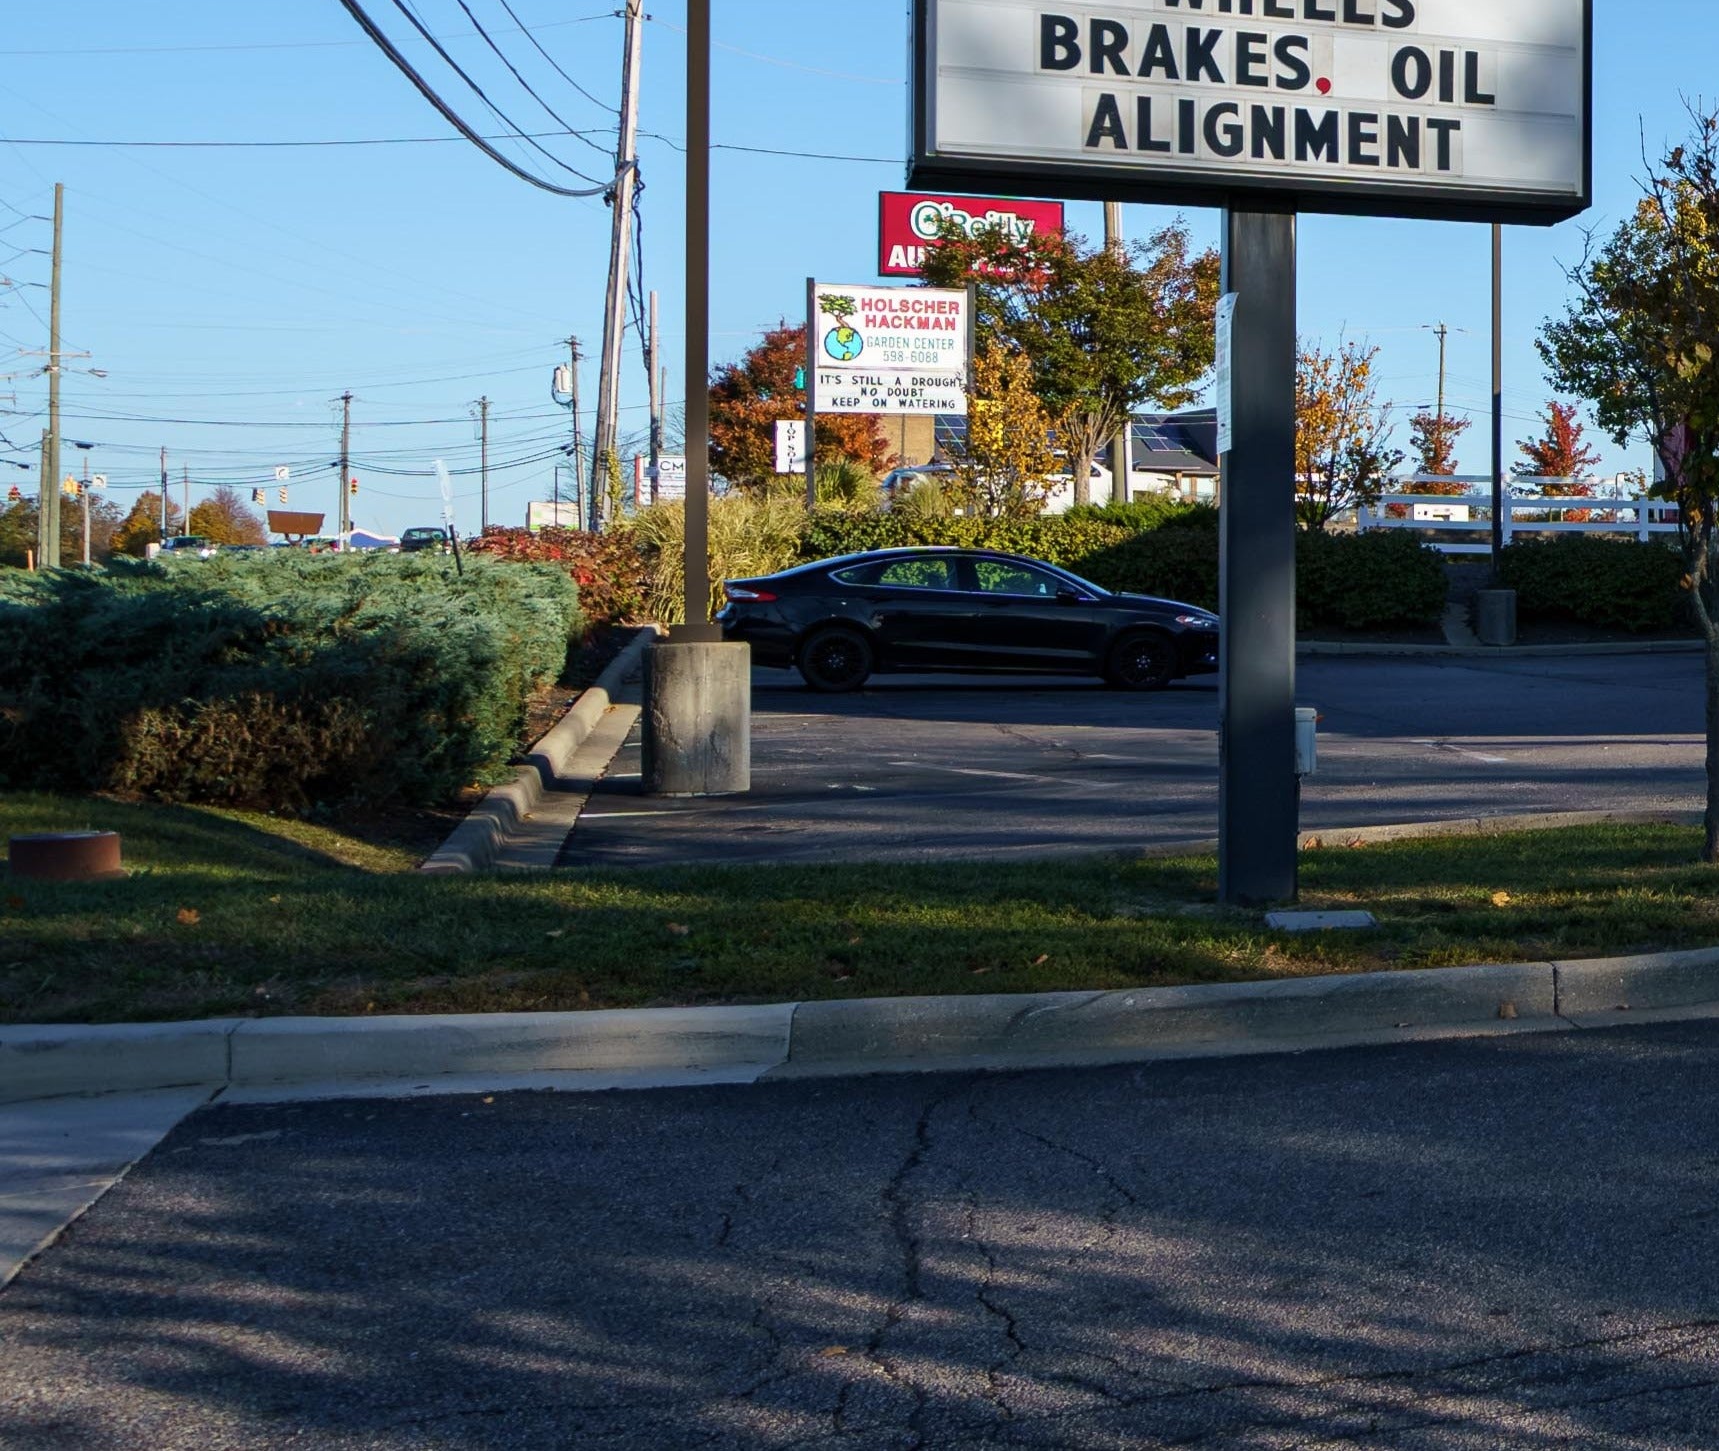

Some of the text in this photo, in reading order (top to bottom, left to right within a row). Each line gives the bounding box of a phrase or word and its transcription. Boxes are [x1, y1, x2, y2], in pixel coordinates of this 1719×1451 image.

[1391, 45, 1497, 106] OIL
[1085, 92, 1462, 172] ALIGNMENT
[861, 298, 960, 315] HOLSCHER
[865, 314, 956, 331] HACKMAN
[867, 336, 955, 350] GARDEN CENTER
[883, 351, 939, 363] 598-6088
[820, 375, 842, 385] IT'S
[852, 375, 883, 385] STILL
[894, 377, 902, 386] A
[860, 387, 924, 397] NO DOUBT
[831, 397, 956, 409] KEEP ON WATERING
